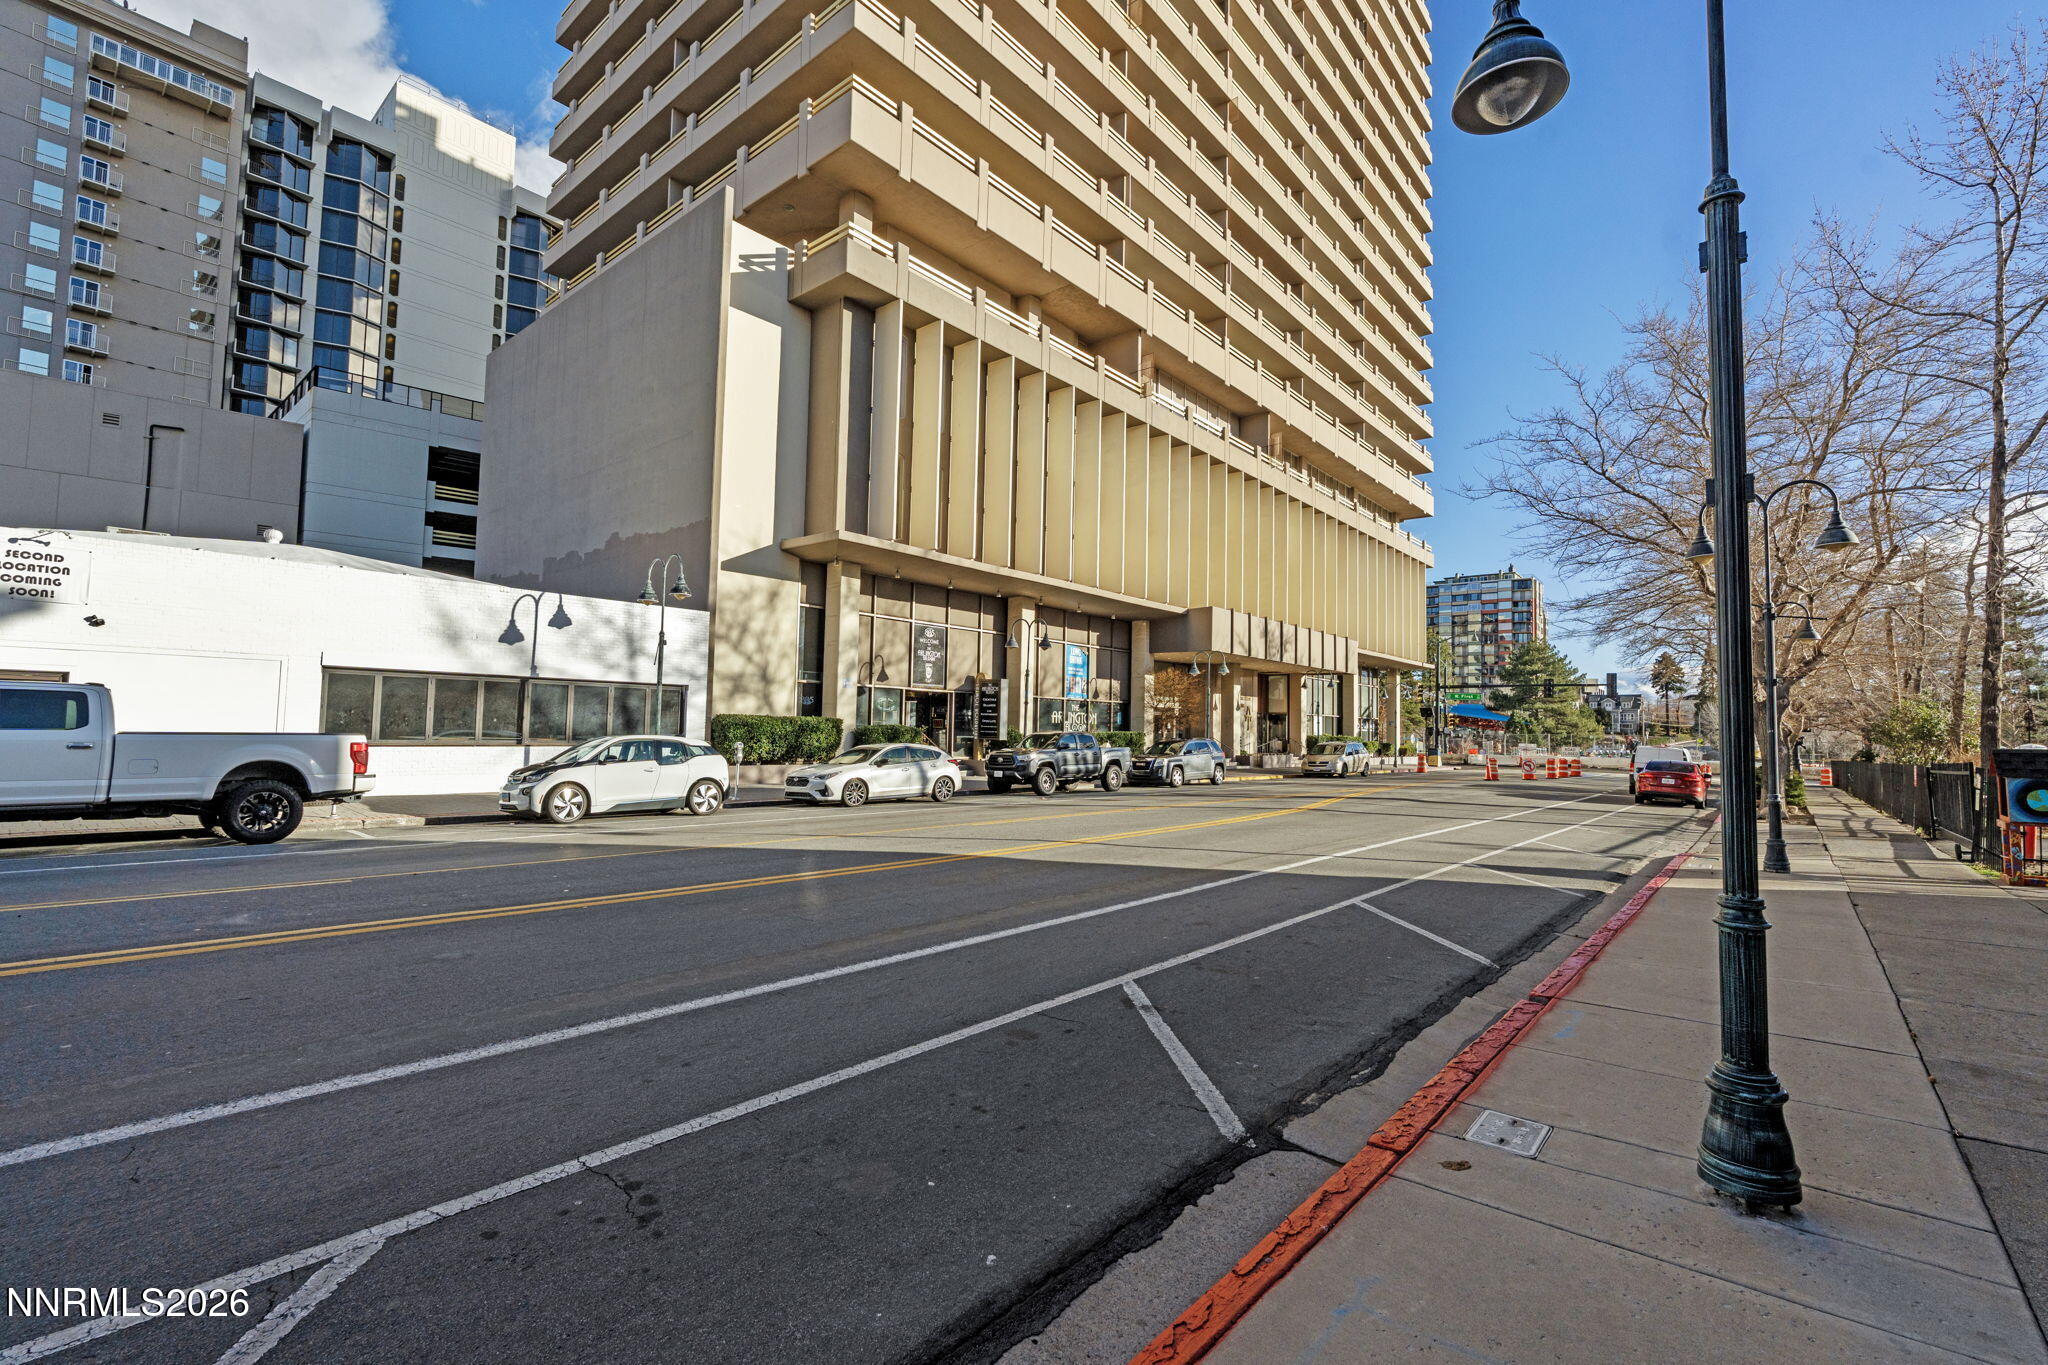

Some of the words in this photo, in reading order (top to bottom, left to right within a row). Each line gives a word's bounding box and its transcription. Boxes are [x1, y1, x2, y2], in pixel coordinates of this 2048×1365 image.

[5, 549, 65, 563] SECOND
[0, 573, 62, 587] COMING
[8, 586, 55, 599] SOON!
[1071, 704, 1080, 712] THE
